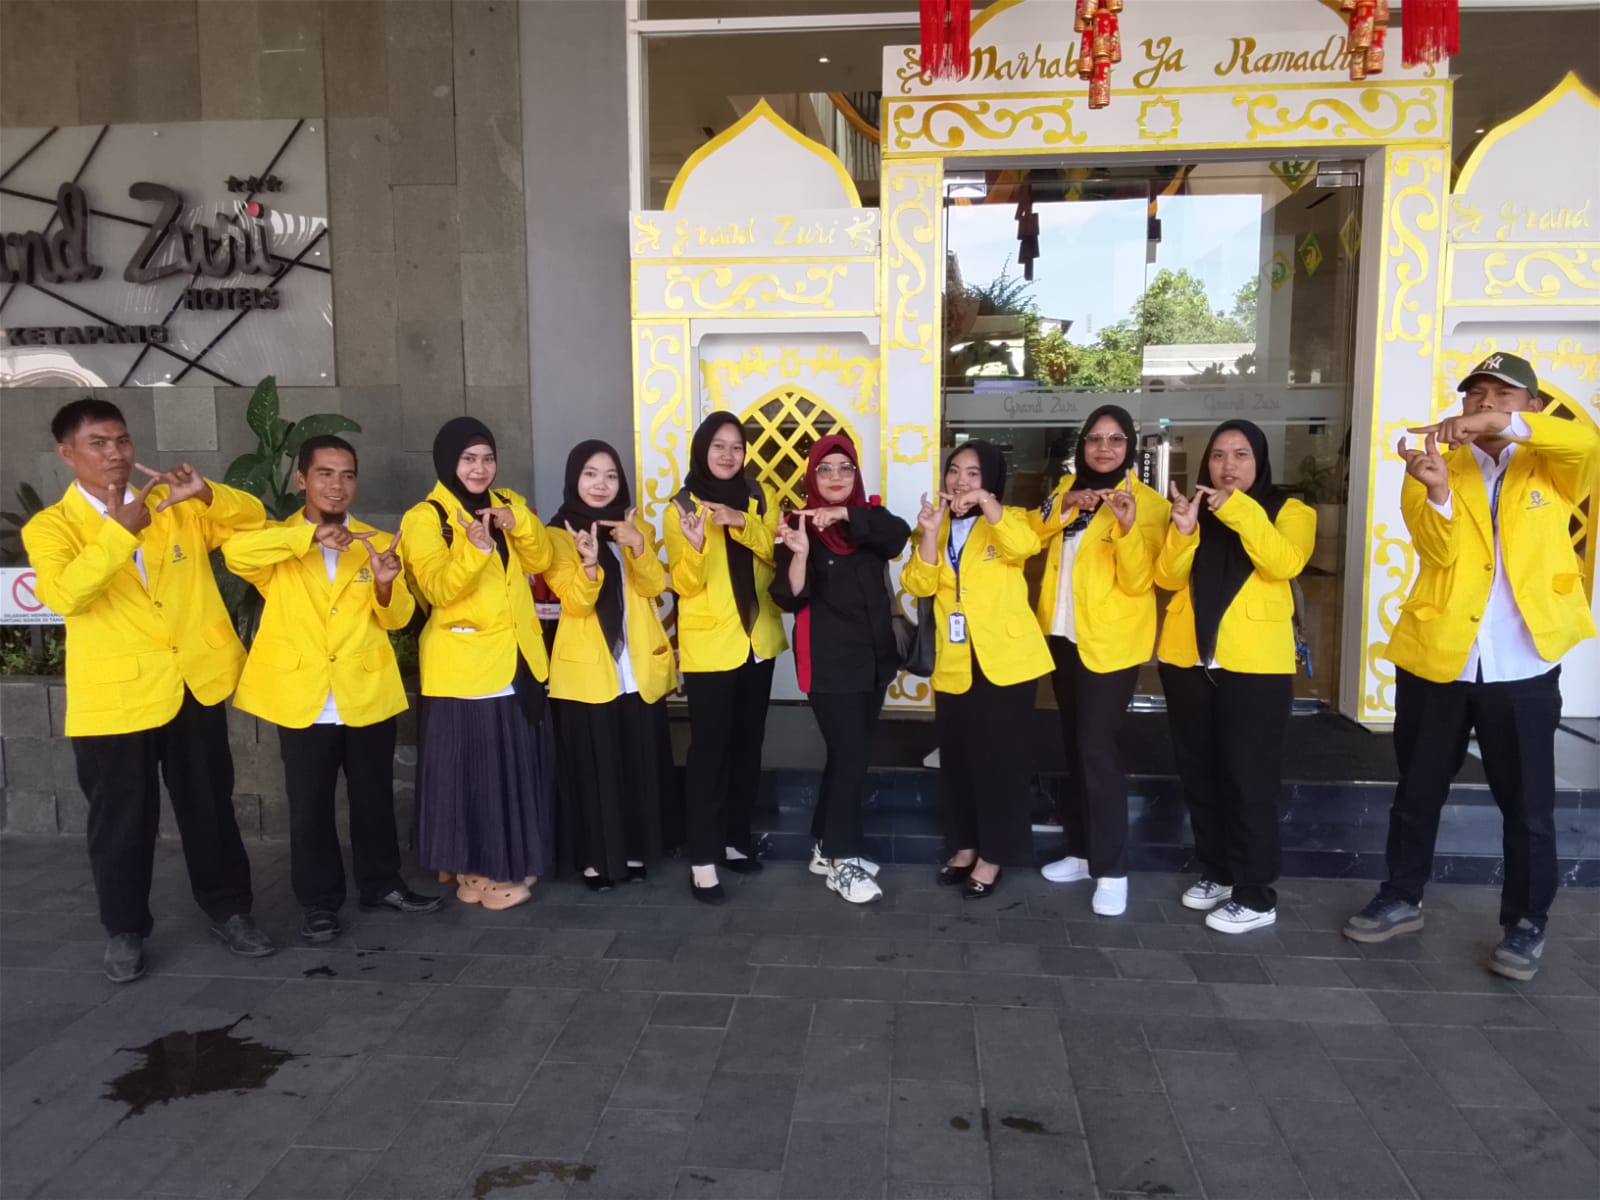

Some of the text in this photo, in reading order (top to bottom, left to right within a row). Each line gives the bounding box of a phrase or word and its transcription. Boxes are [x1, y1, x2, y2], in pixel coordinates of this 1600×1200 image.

[957, 35, 1352, 88] Marhab Ya Ramadh
[0, 182, 285, 284] nd Zuri
[671, 215, 838, 257] Grand Zuri
[1495, 199, 1591, 242] Grand
[183, 287, 280, 311] HOTELS
[5, 324, 168, 346] KETAPANG
[1003, 396, 1077, 419] Grand Zuri
[1203, 393, 1280, 418] Grand Zuri
[1143, 453, 1151, 485] DORON
